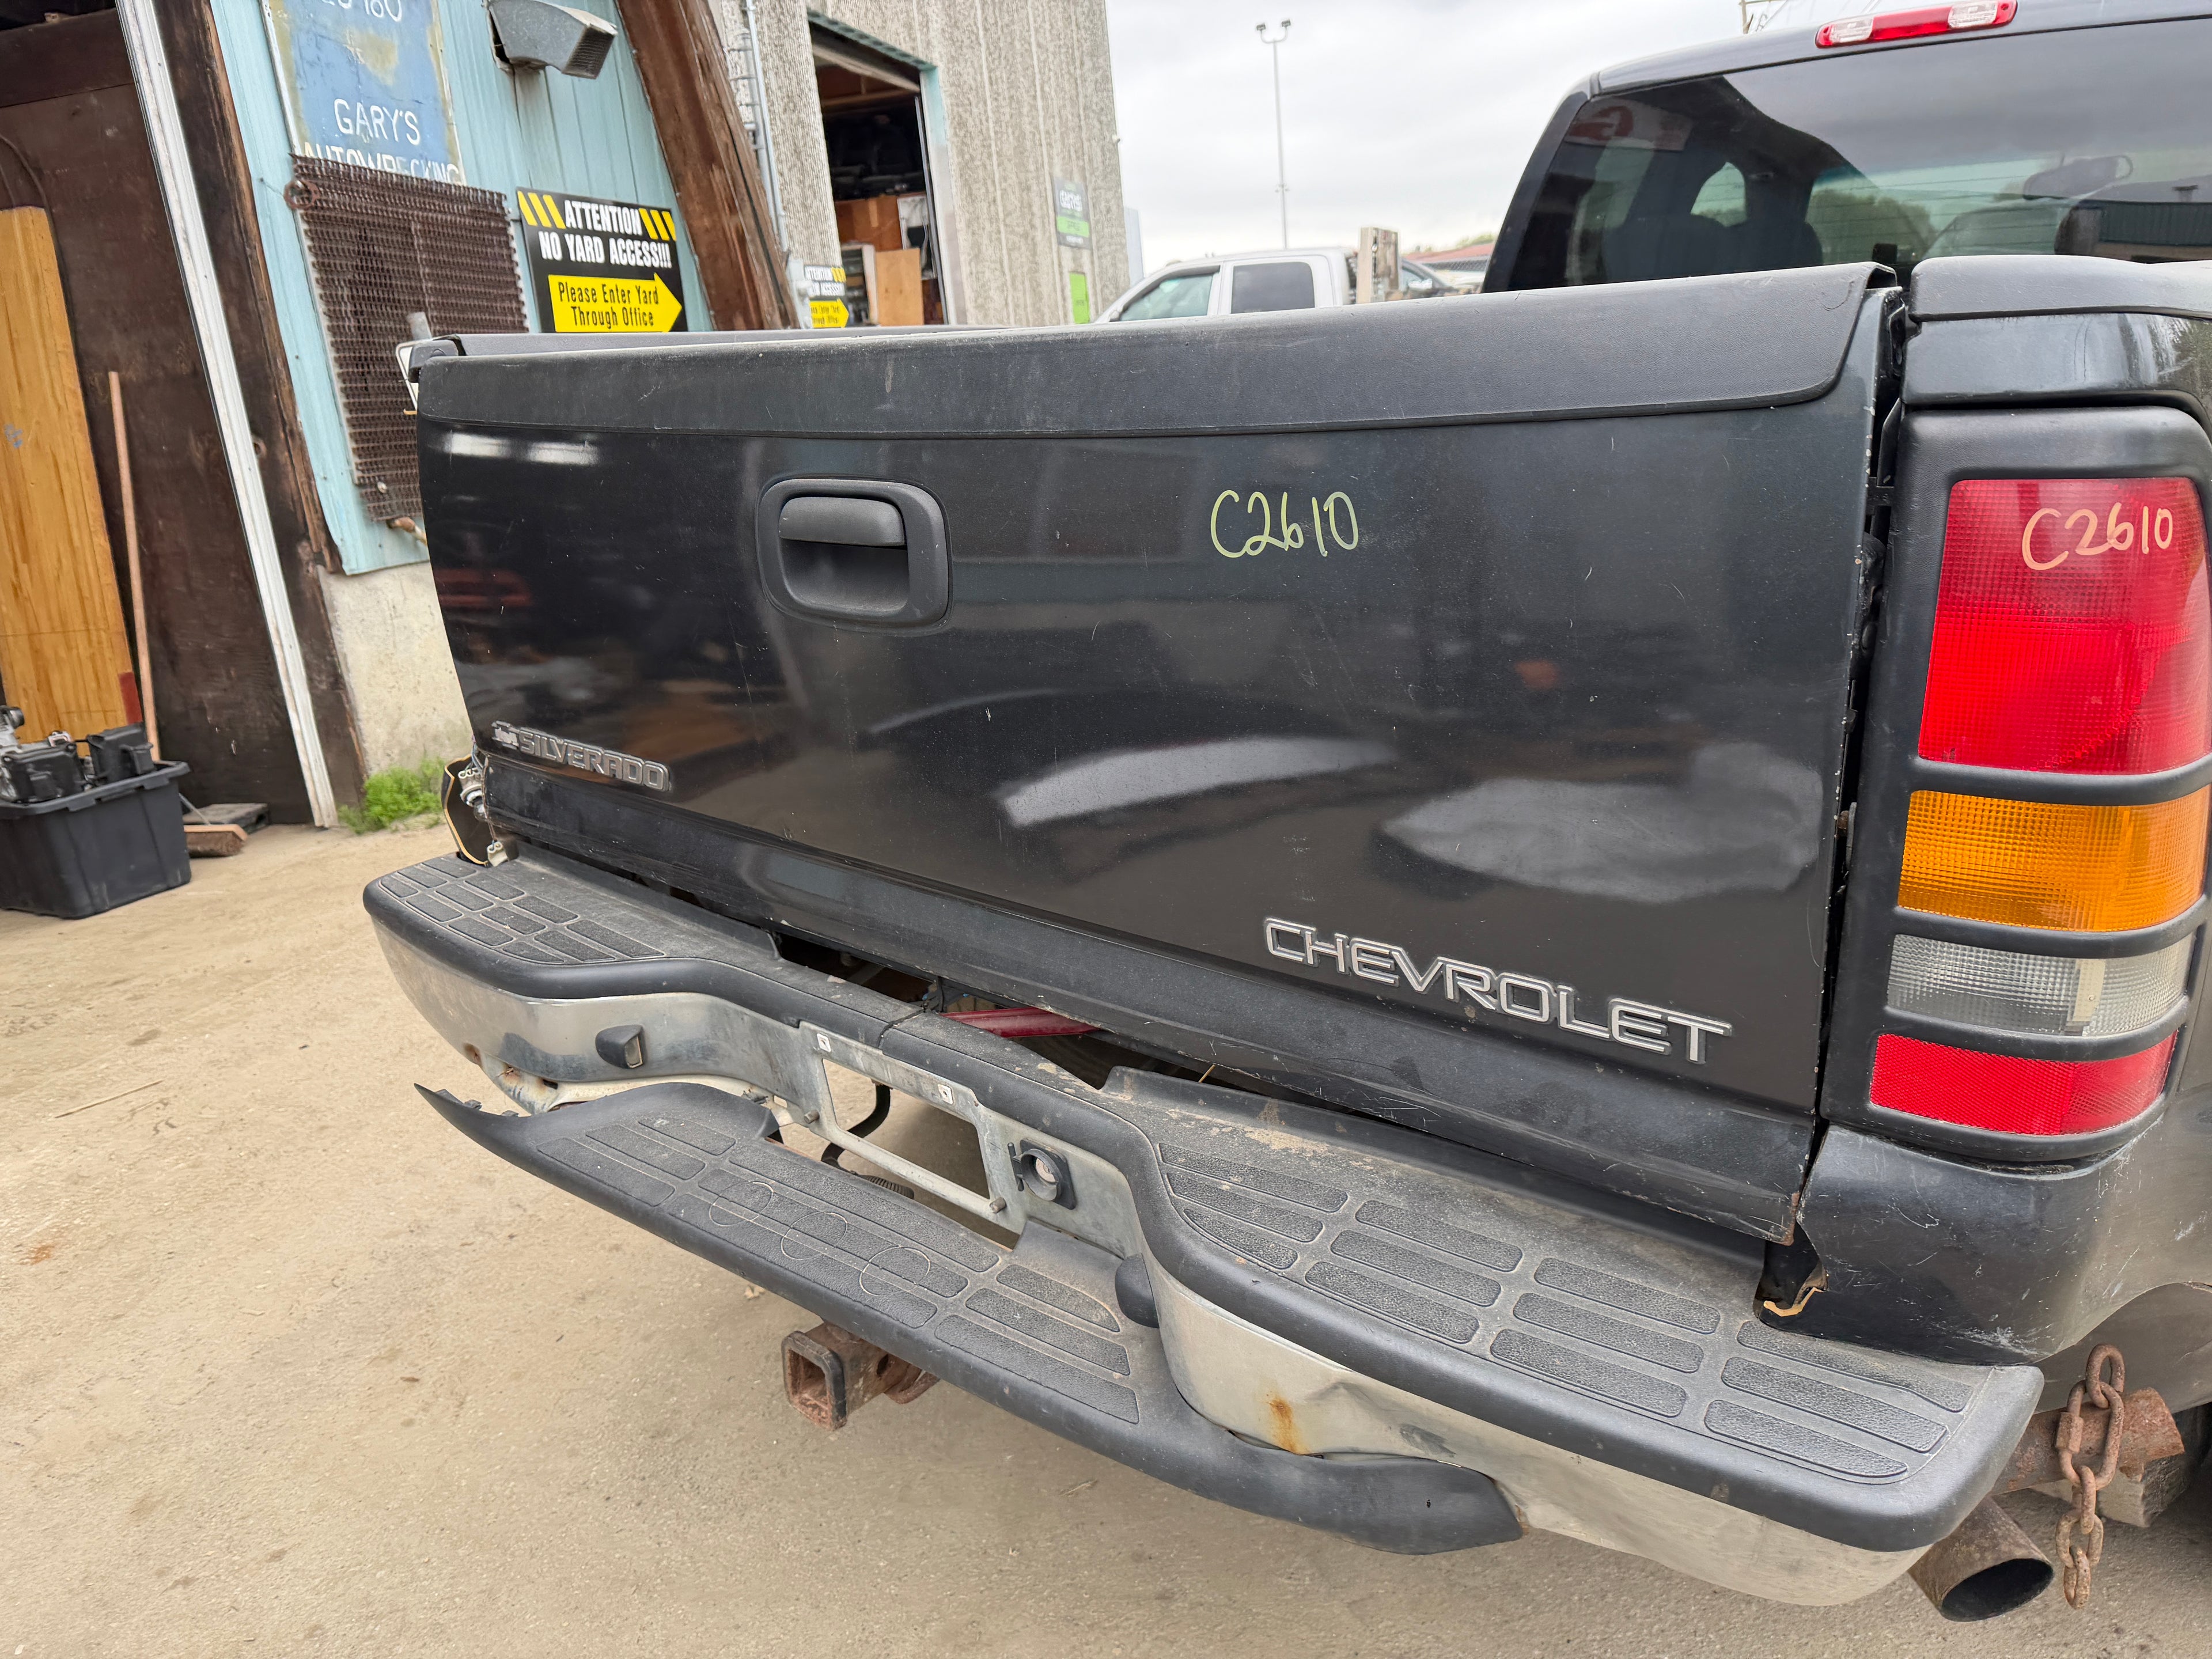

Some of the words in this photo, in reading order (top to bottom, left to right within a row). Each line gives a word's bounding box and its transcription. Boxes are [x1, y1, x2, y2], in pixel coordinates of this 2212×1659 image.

[334, 99, 421, 146] GARY'S
[565, 200, 643, 236] ATTENTION
[538, 230, 563, 260] NO
[564, 233, 605, 264] YARD
[609, 237, 672, 268] ACCESS!!!
[558, 281, 598, 303] Please
[602, 283, 631, 305] Enter
[634, 285, 659, 305] Yard
[570, 305, 618, 329] Through
[622, 306, 654, 327] Office
[1210, 490, 1359, 559] C2610
[2021, 502, 2173, 571] C2610
[518, 728, 671, 792] SILVERADO
[1264, 916, 1733, 1065] CHEVROLET
